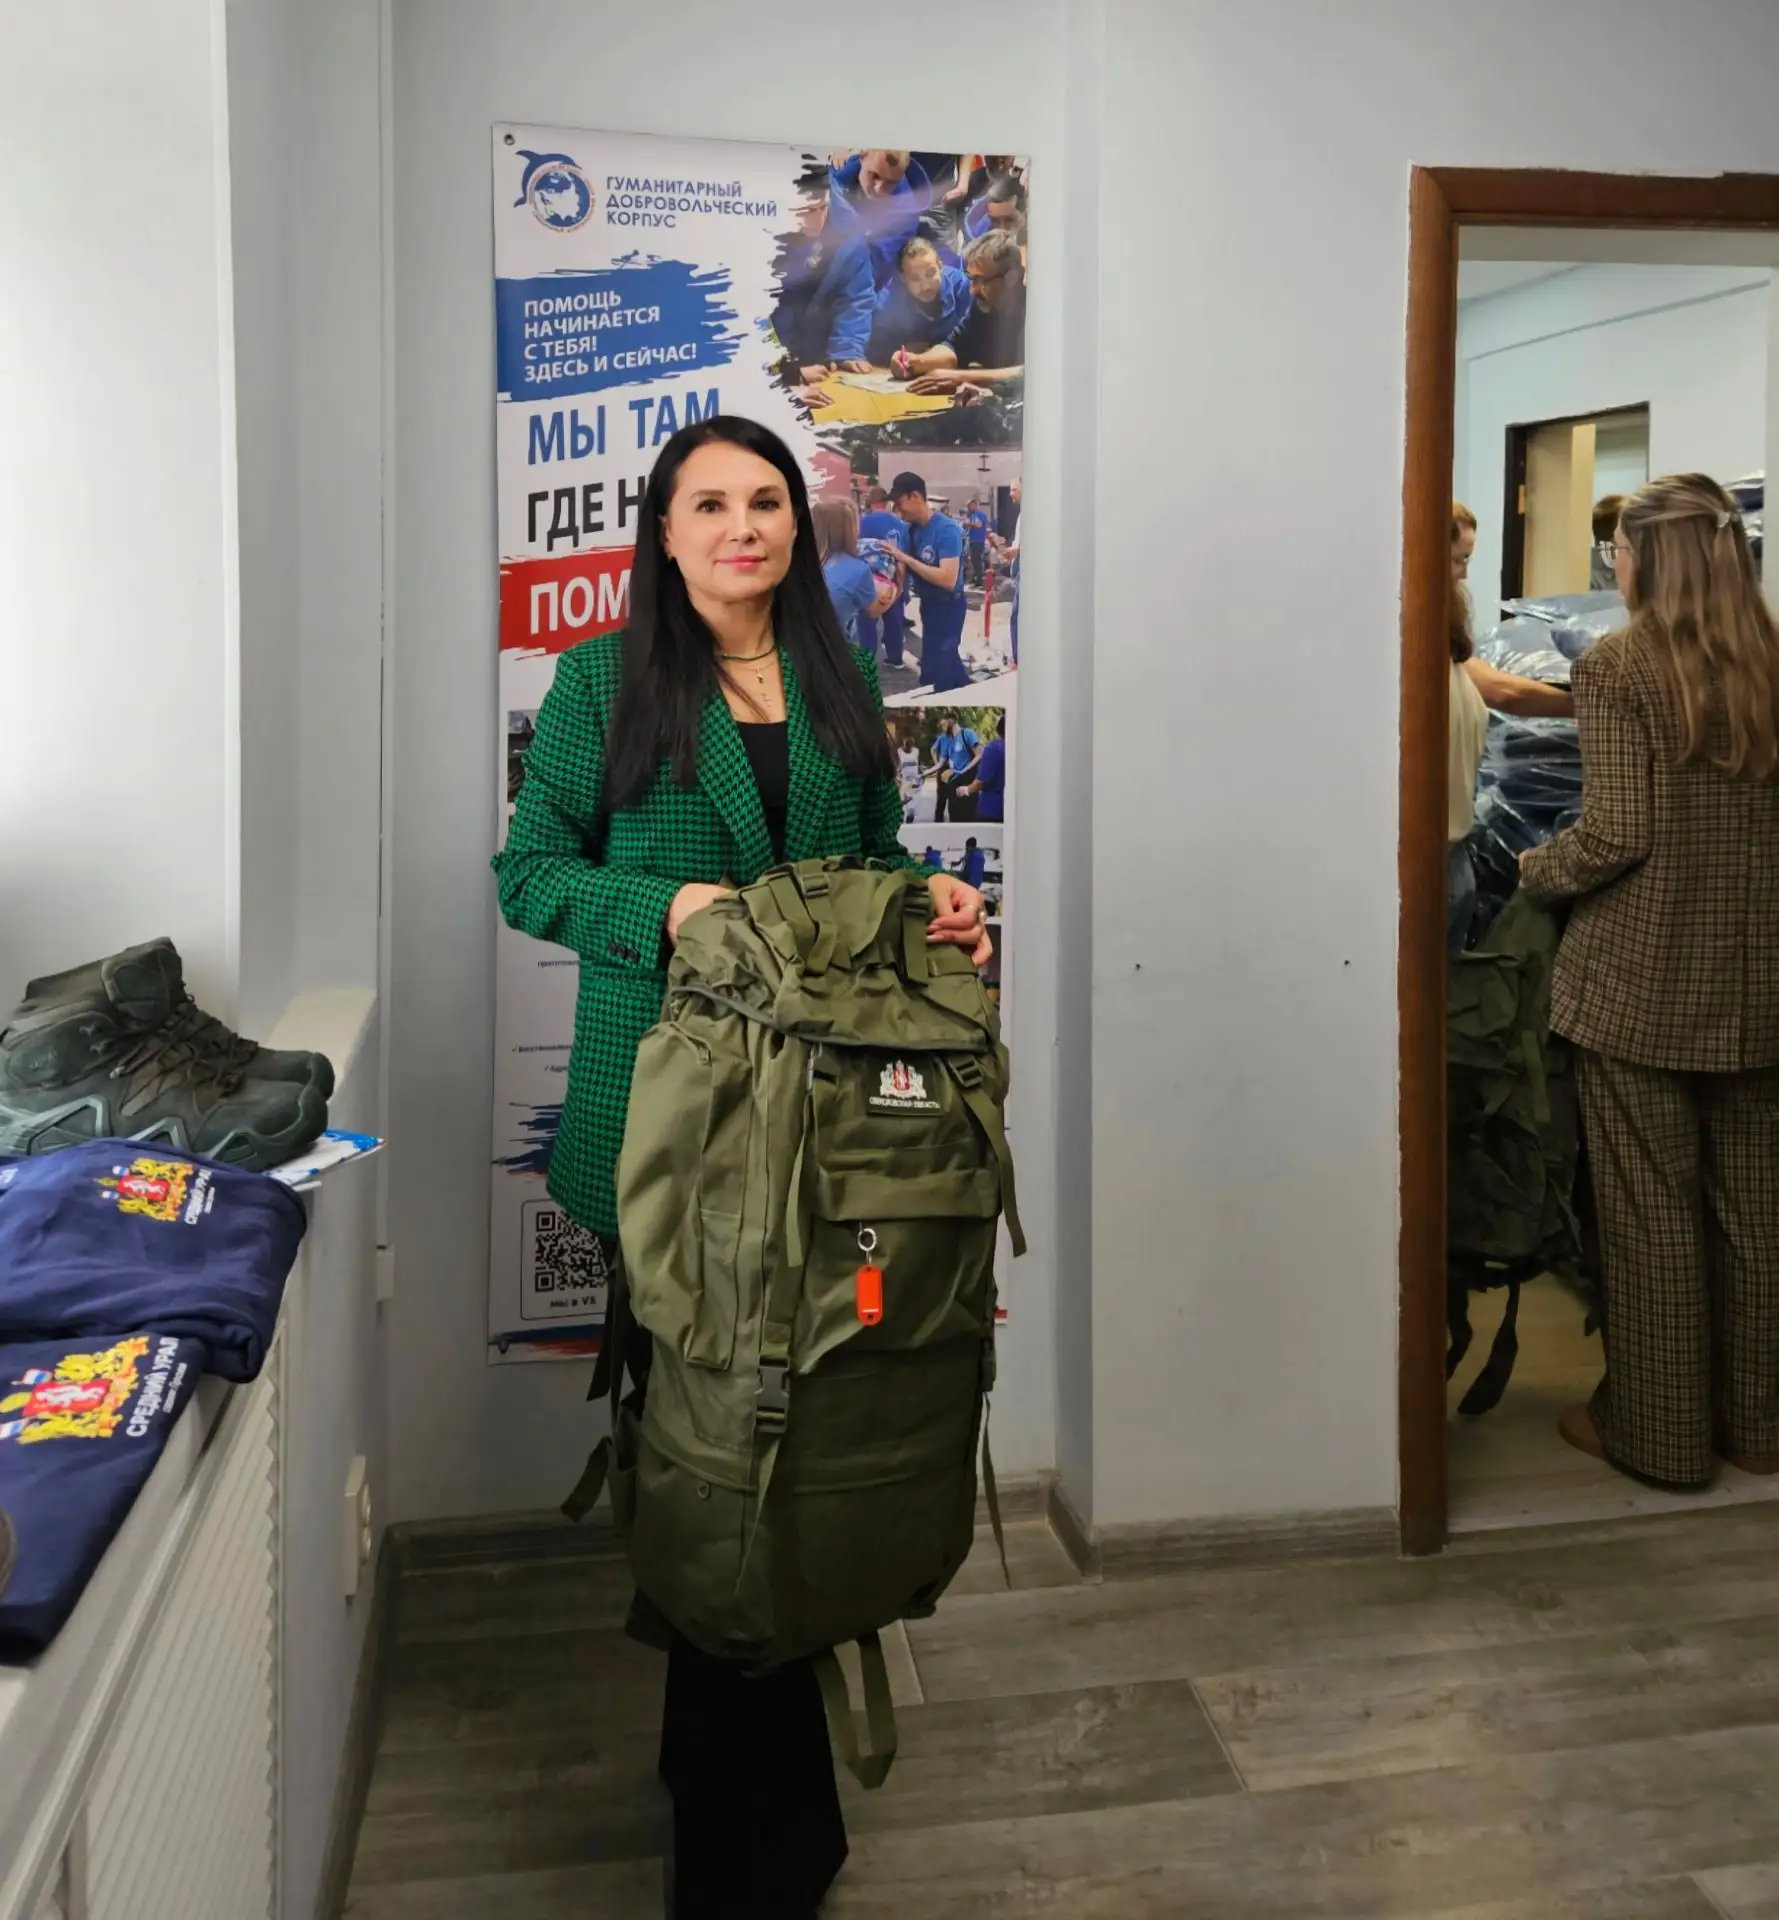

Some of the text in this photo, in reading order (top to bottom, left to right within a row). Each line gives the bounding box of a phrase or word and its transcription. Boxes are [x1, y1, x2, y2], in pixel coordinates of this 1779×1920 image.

[606, 176, 742, 197] ГУМАНИТАРНЫЙ
[606, 194, 777, 217] ДОБРОВОЛЬЧЕСКИЙ
[606, 212, 676, 228] КОРПУС
[524, 290, 621, 318] ПОМОЩЬ
[524, 306, 660, 339] НАЧИНАЕТСЯ
[524, 336, 597, 360] С ТЕБЯ!
[524, 342, 697, 384] ЗДЕСЬ И СЕЙЧАС!
[528, 388, 720, 465] МЫ ТАМ
[528, 482, 604, 552] ГДЕ
[530, 571, 630, 635] ПОМ
[126, 1371, 169, 1437] СРЕДНИЙ
[152, 1337, 180, 1371] УРАЛ
